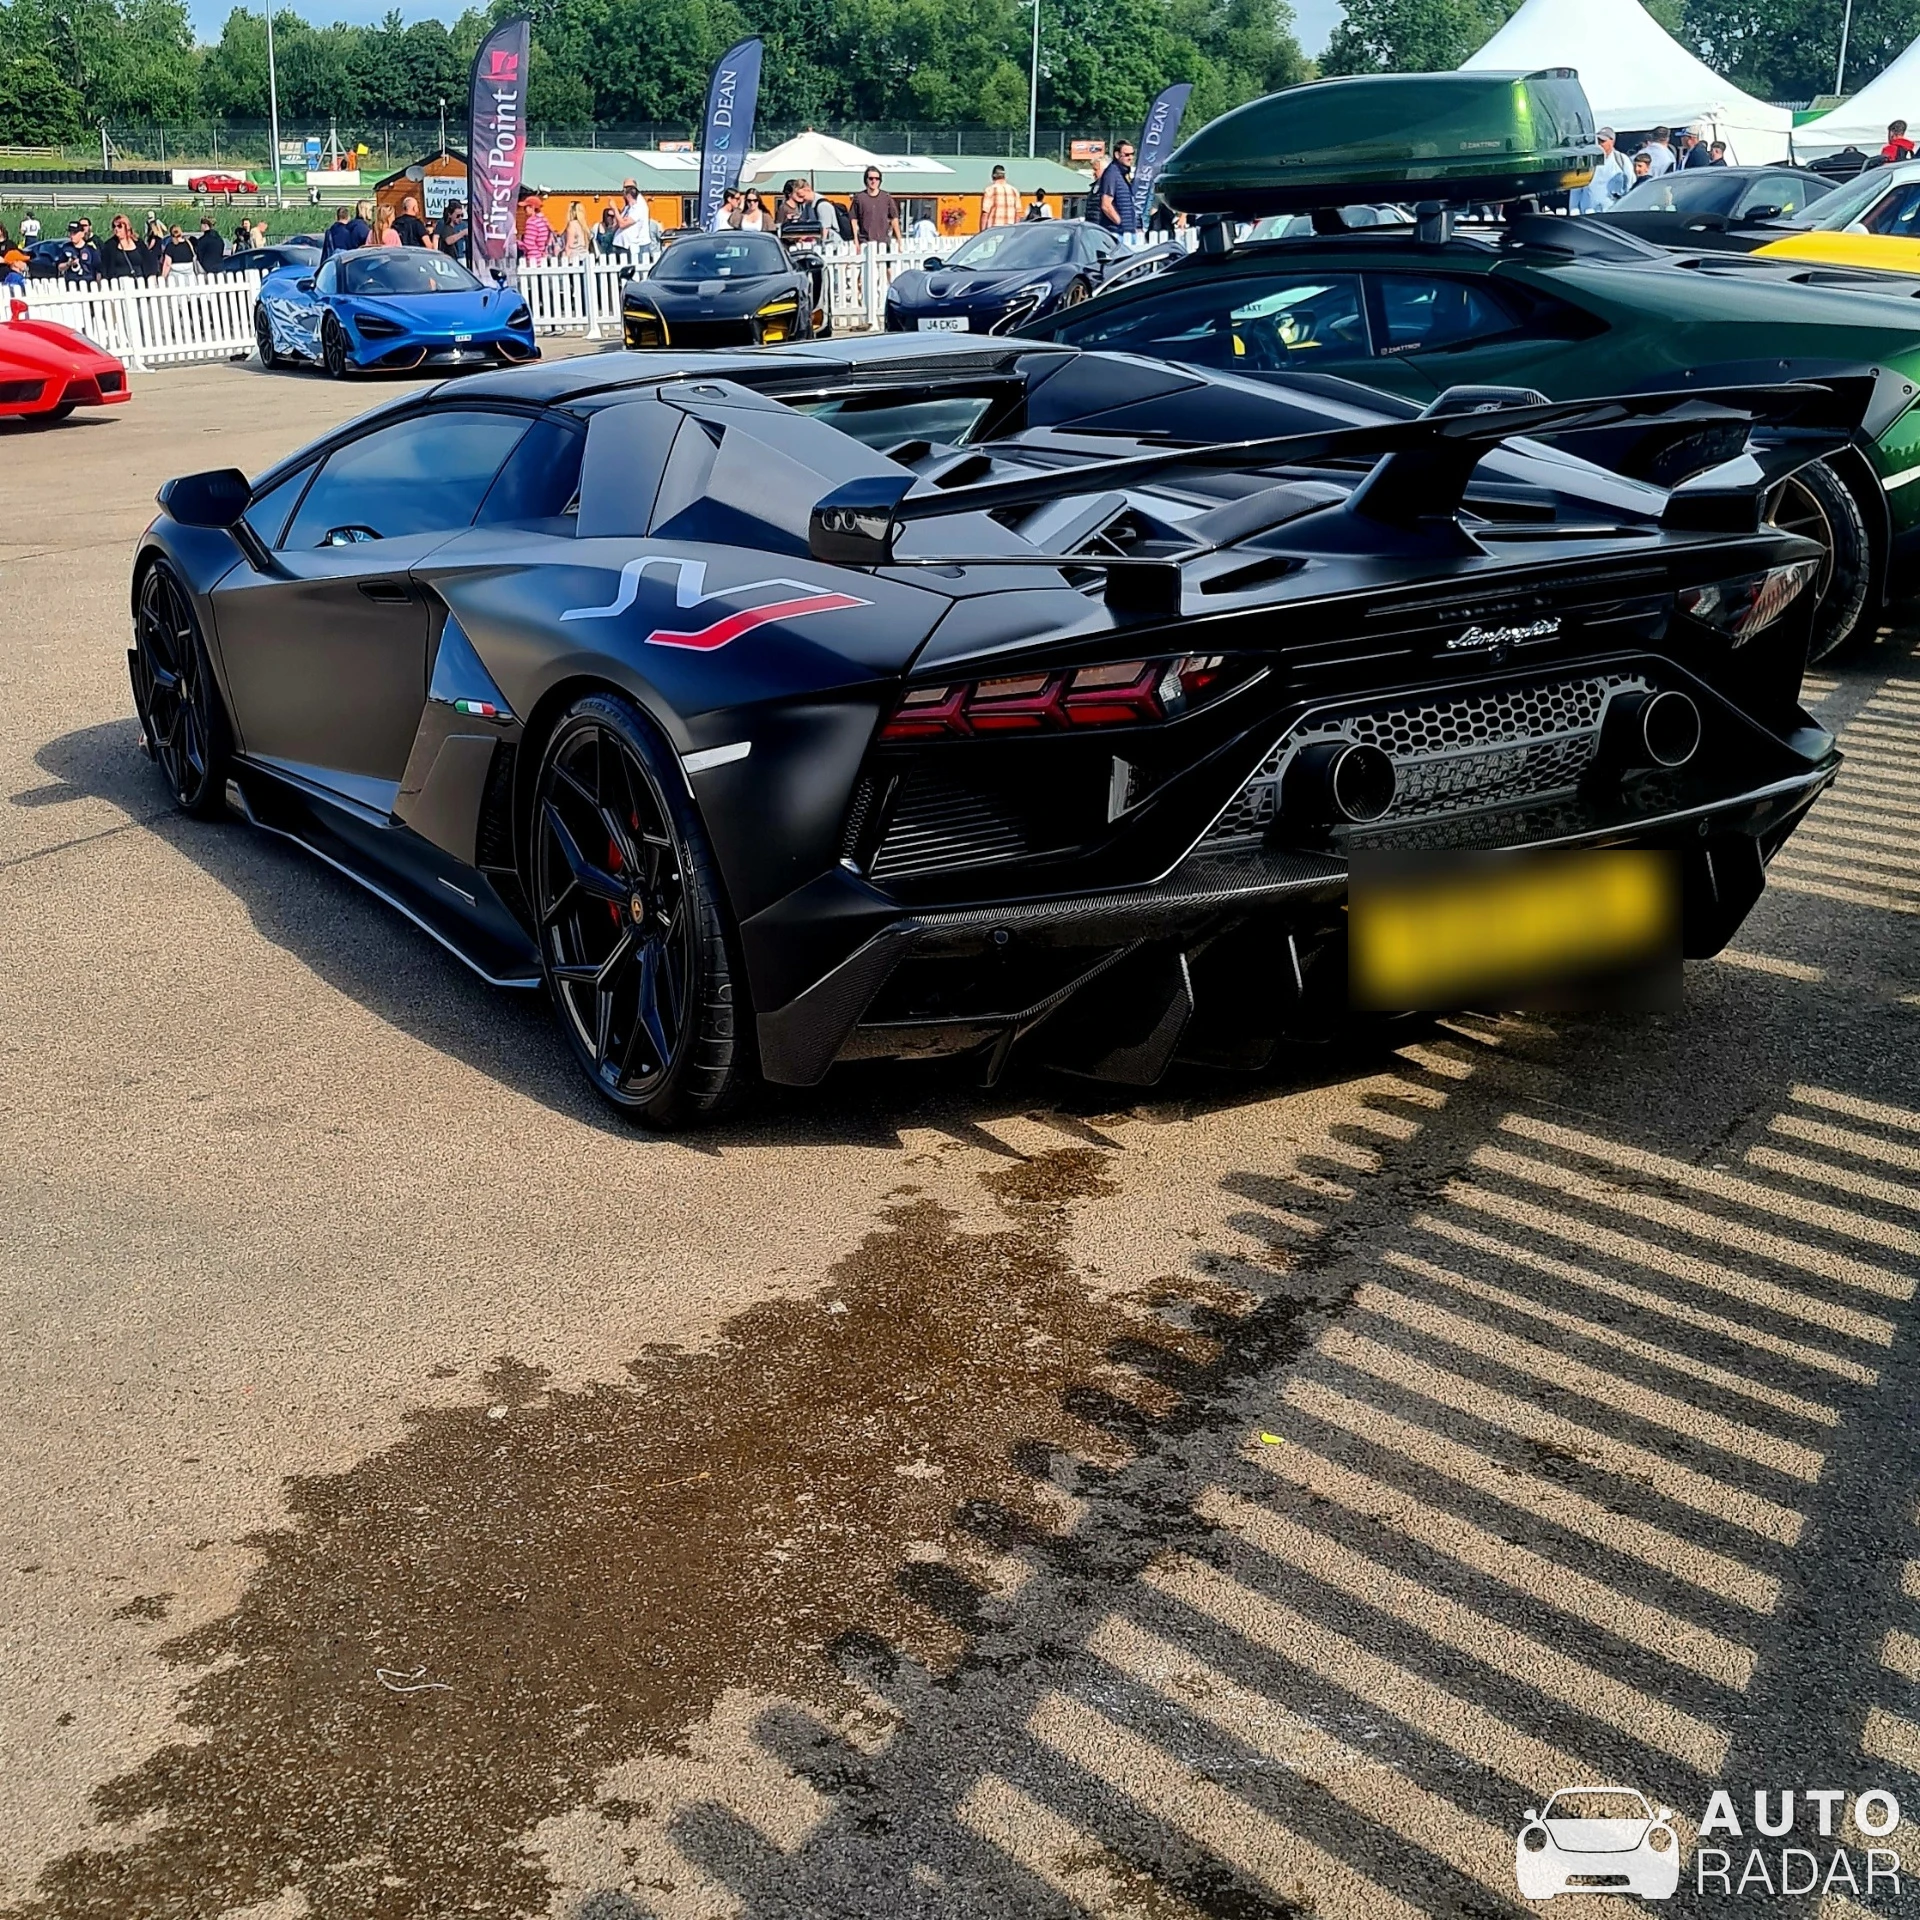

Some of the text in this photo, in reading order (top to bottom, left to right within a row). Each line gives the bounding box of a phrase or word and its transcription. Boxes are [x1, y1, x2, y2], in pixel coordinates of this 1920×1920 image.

[713, 70, 737, 128] DEAN
[483, 88, 518, 242] First Point
[714, 132, 731, 150] &
[1134, 101, 1170, 219] ARLES & DEAN
[927, 320, 938, 330] J4
